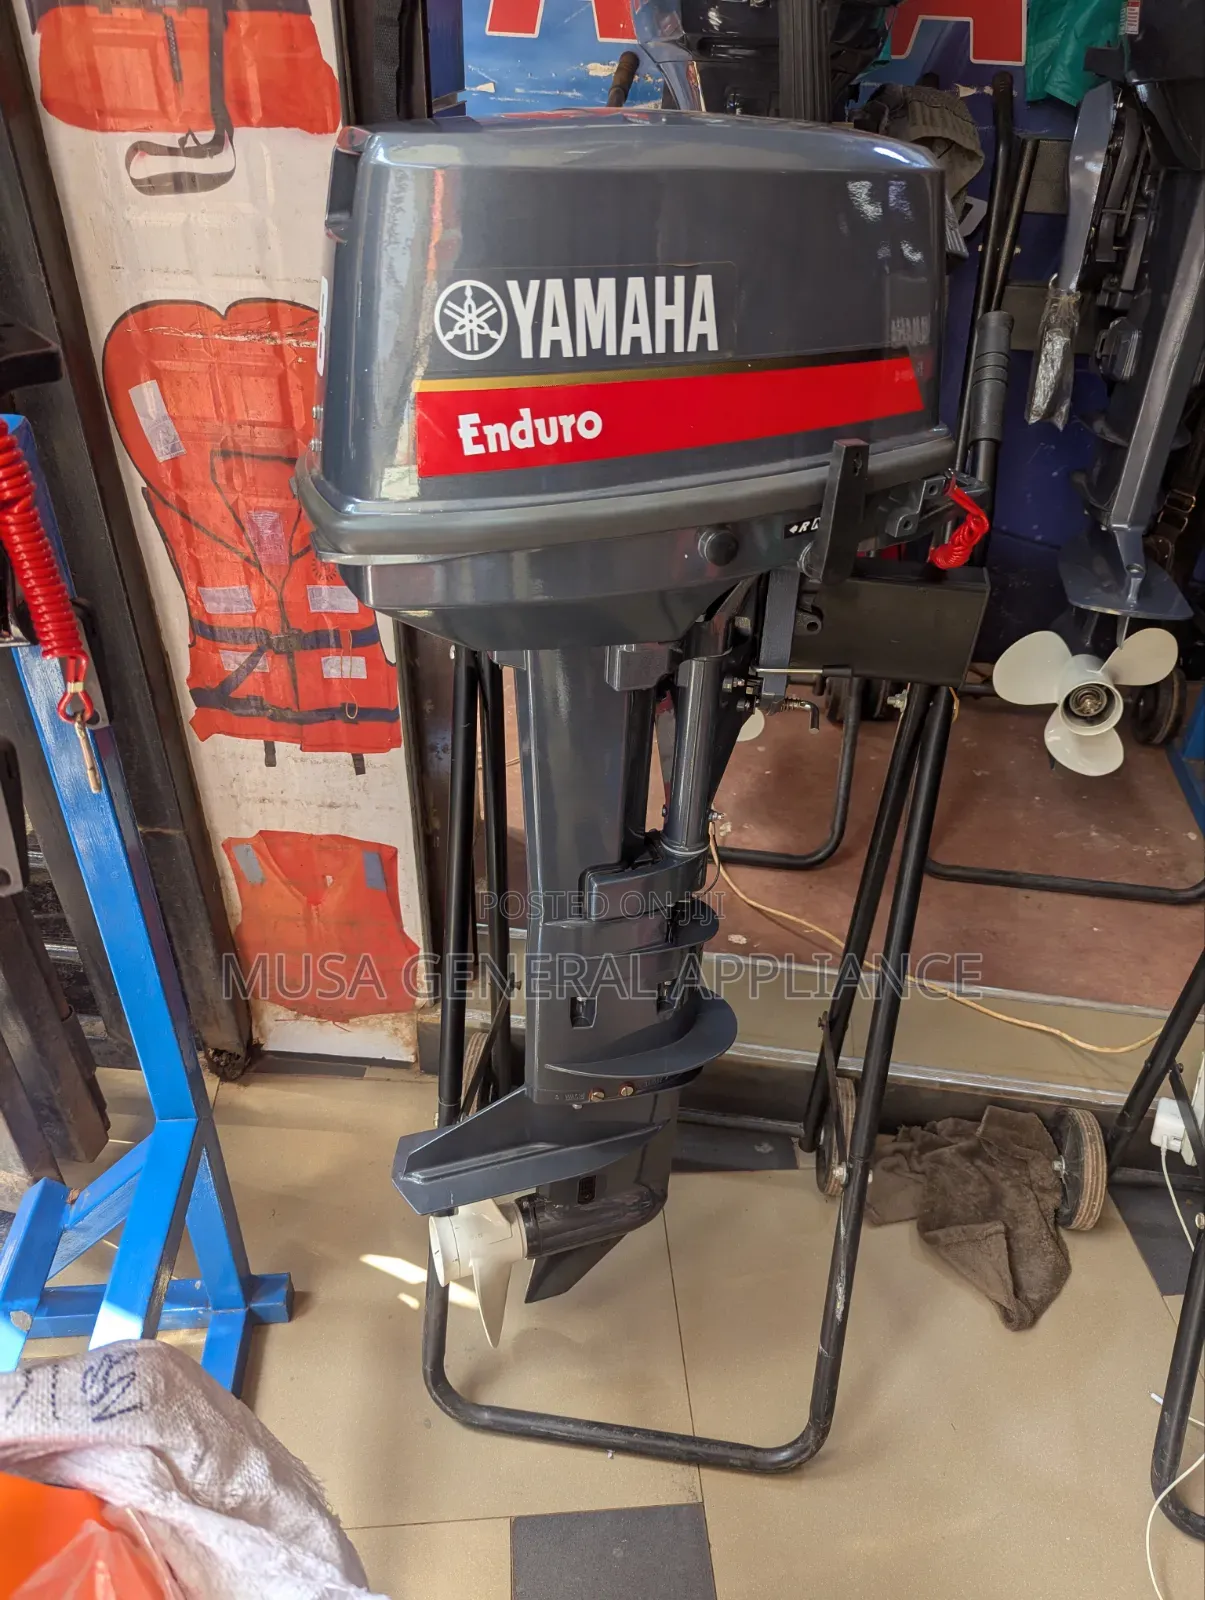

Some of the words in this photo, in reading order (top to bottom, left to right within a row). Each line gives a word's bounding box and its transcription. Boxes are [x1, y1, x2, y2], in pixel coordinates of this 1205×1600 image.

[506, 274, 719, 359] YAMAHA
[457, 407, 603, 456] Enduro
[798, 521, 811, 533] R
